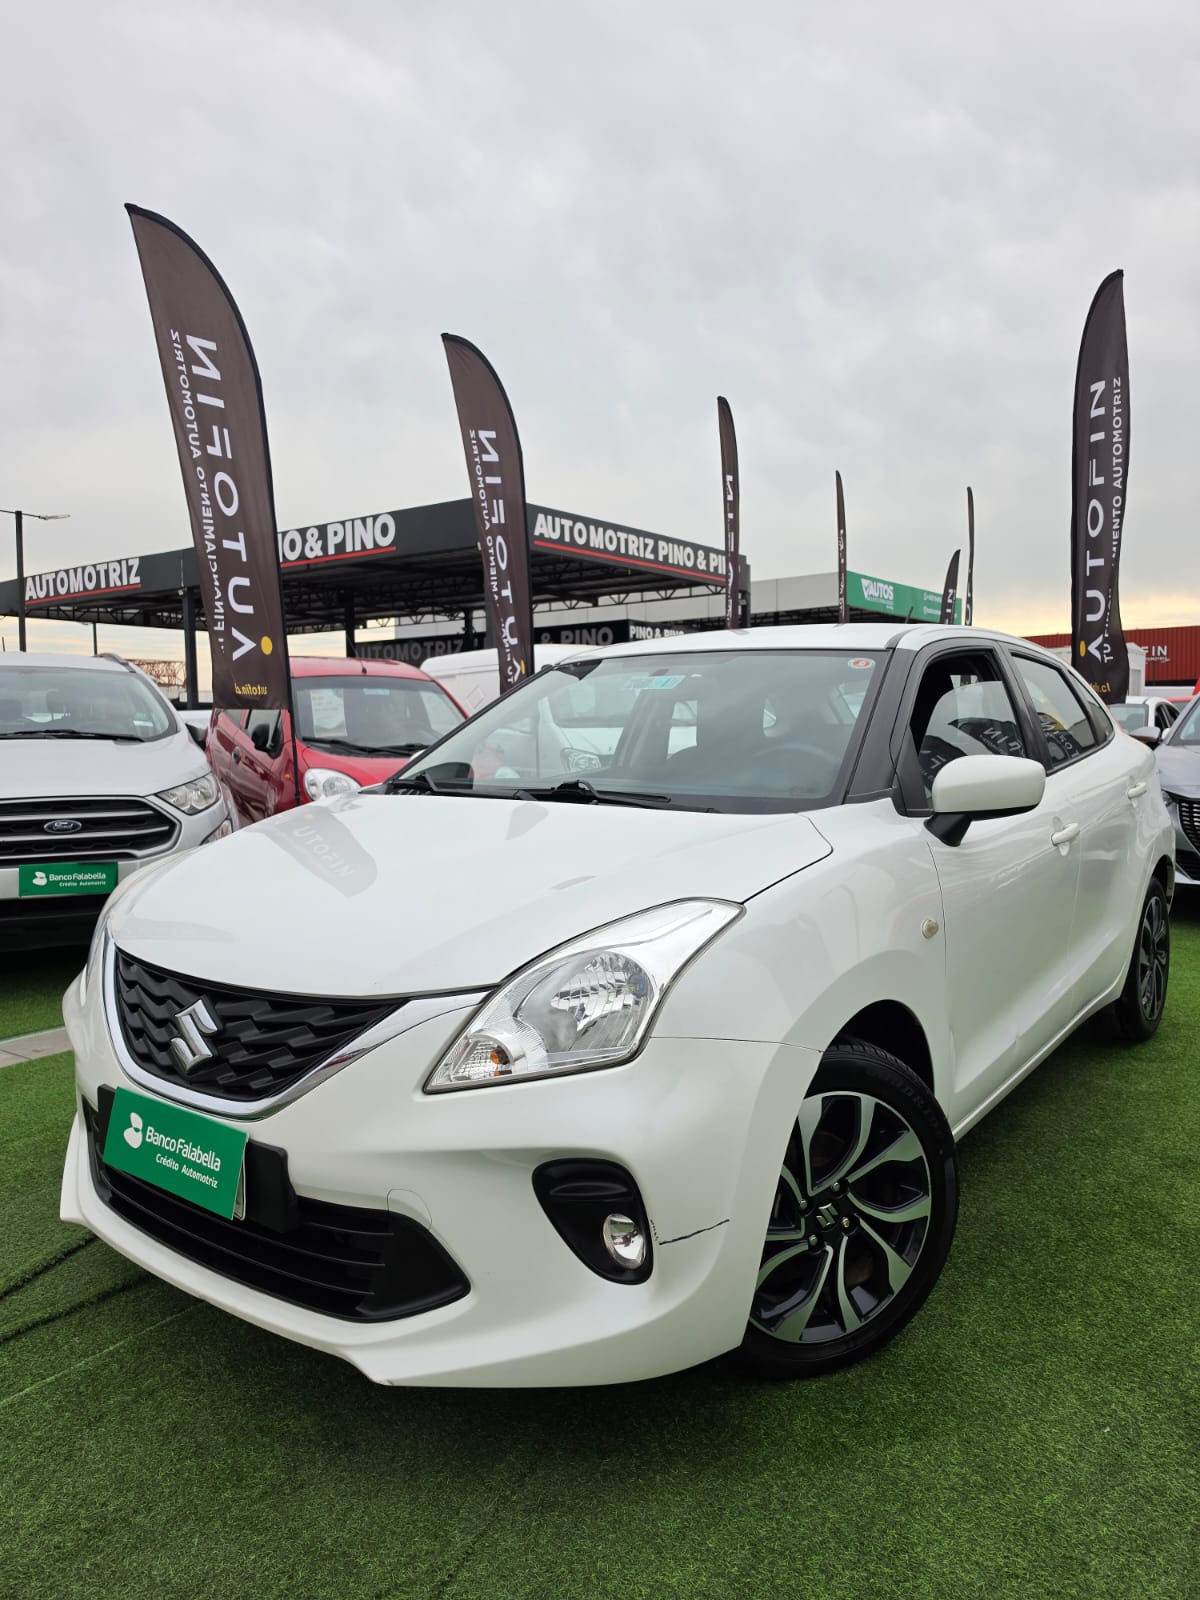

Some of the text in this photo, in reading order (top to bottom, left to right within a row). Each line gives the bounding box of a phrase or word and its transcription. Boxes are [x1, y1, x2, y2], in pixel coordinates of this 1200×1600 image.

[1112, 376, 1123, 489] AUTOMOTRIZ
[327, 513, 396, 555] PINO
[534, 513, 655, 560] AUTOMOTRIZ
[658, 541, 695, 568] PINO
[696, 550, 707, 571] &
[1085, 380, 1106, 663] AUTOFIN
[24, 557, 141, 601] AUTOMOTRIZ
[560, 627, 614, 646] PINO
[629, 624, 653, 639] PINO
[155, 1153, 218, 1189] Crédito Automotriz
